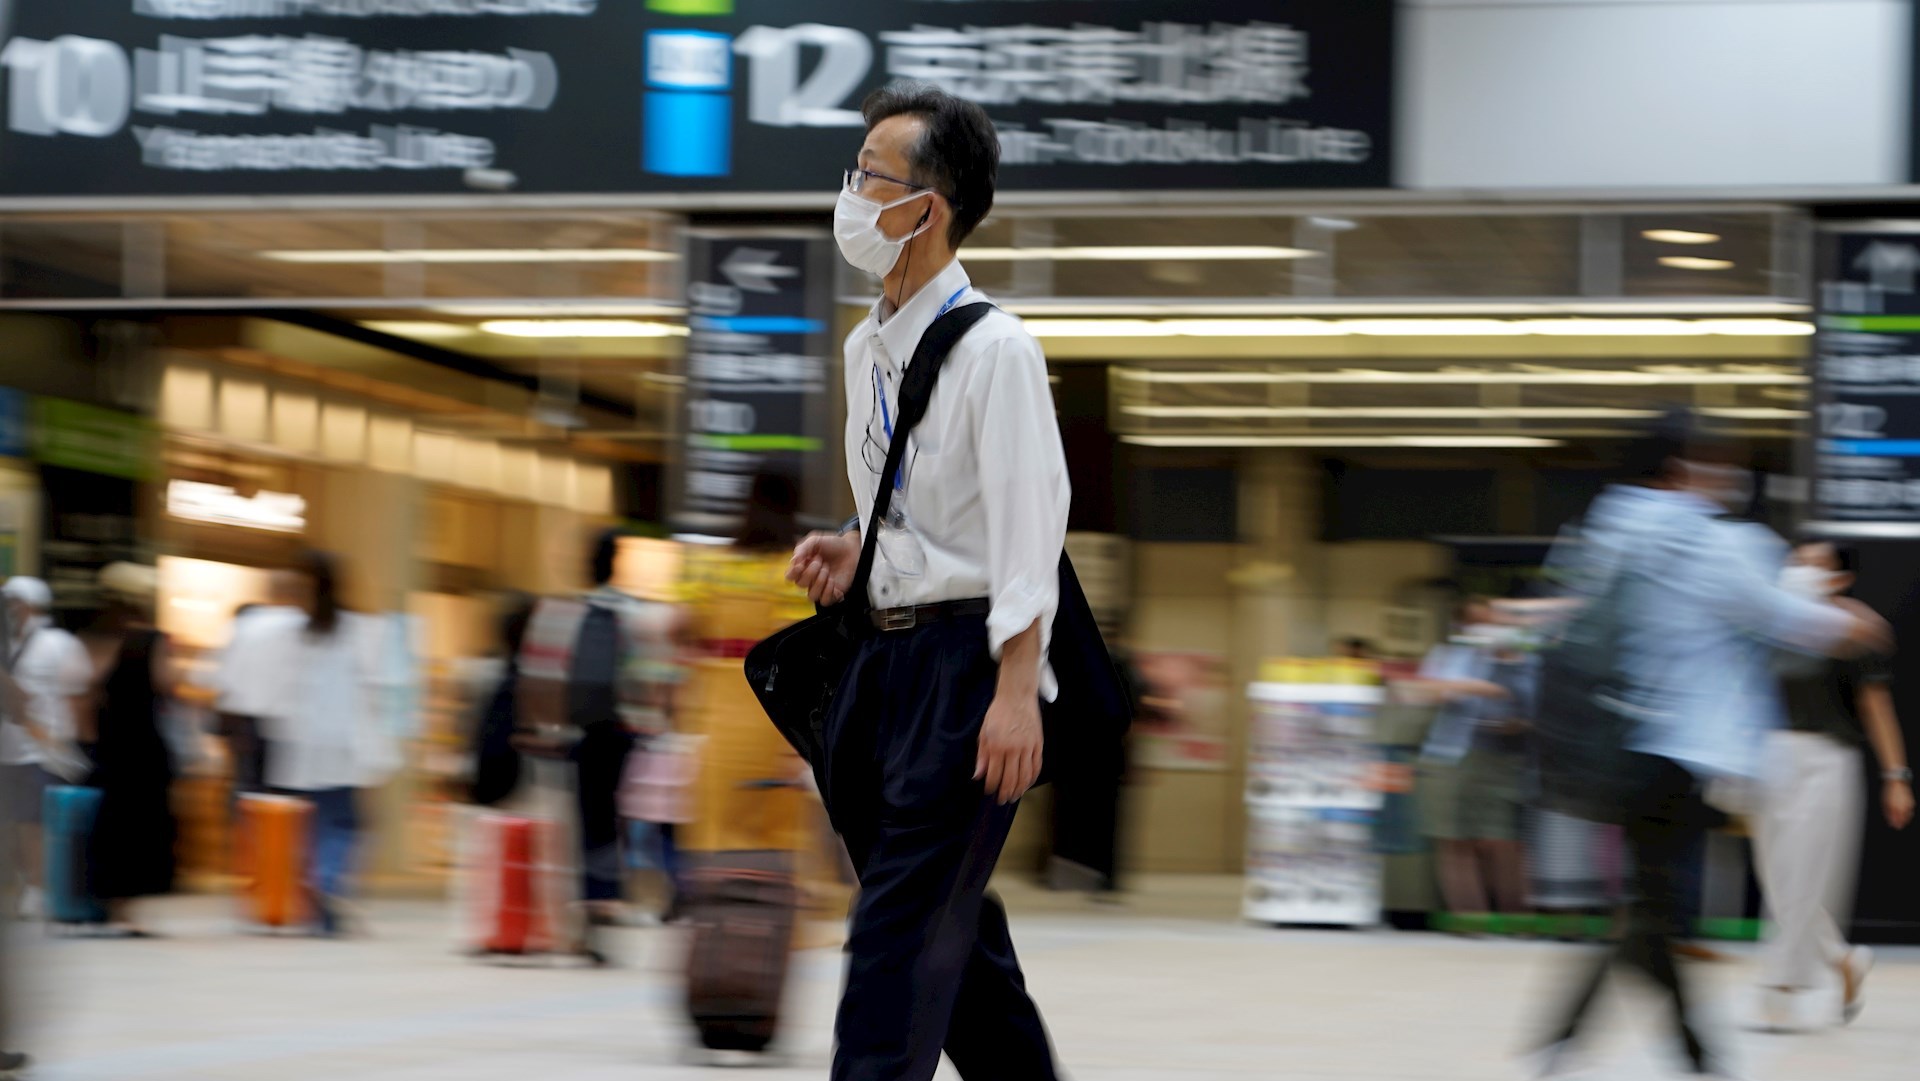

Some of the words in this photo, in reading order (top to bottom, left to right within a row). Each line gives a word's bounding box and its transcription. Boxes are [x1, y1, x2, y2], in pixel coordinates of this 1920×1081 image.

[3, 36, 132, 138] 10
[733, 23, 874, 127] 12
[1240, 118, 1372, 163] Line
